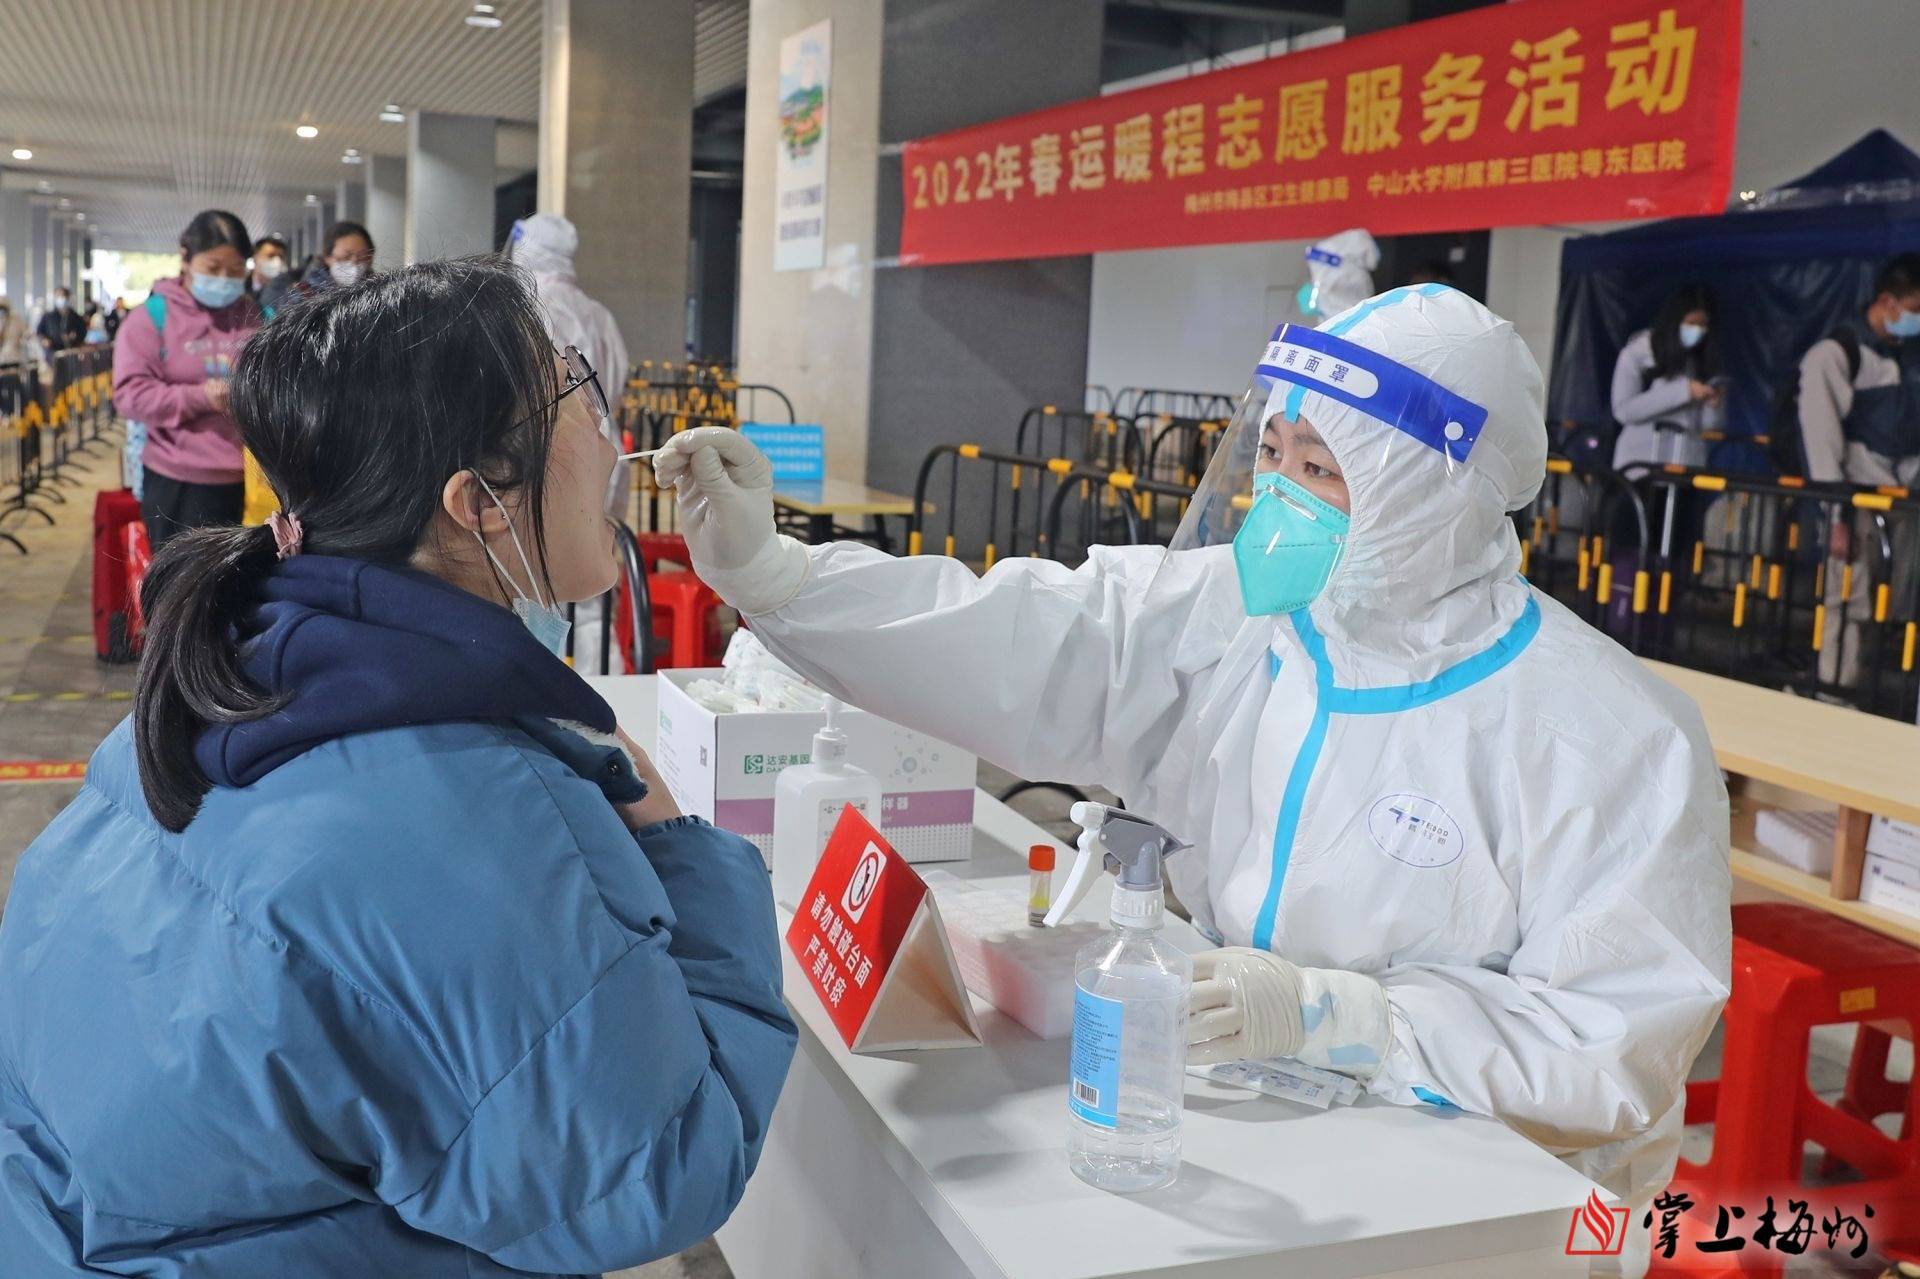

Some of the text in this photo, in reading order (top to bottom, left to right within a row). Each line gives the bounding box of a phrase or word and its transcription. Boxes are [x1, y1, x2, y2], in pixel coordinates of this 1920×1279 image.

[913, 8, 1698, 207] 2022年春运暖程志愿服务活动
[1366, 138, 1687, 197] 中山大学附属第三医院粤东医院
[766, 754, 810, 766] 达安基因
[804, 933, 847, 1009] 严禁吐痰
[810, 890, 873, 989] 请勿触碰台面
